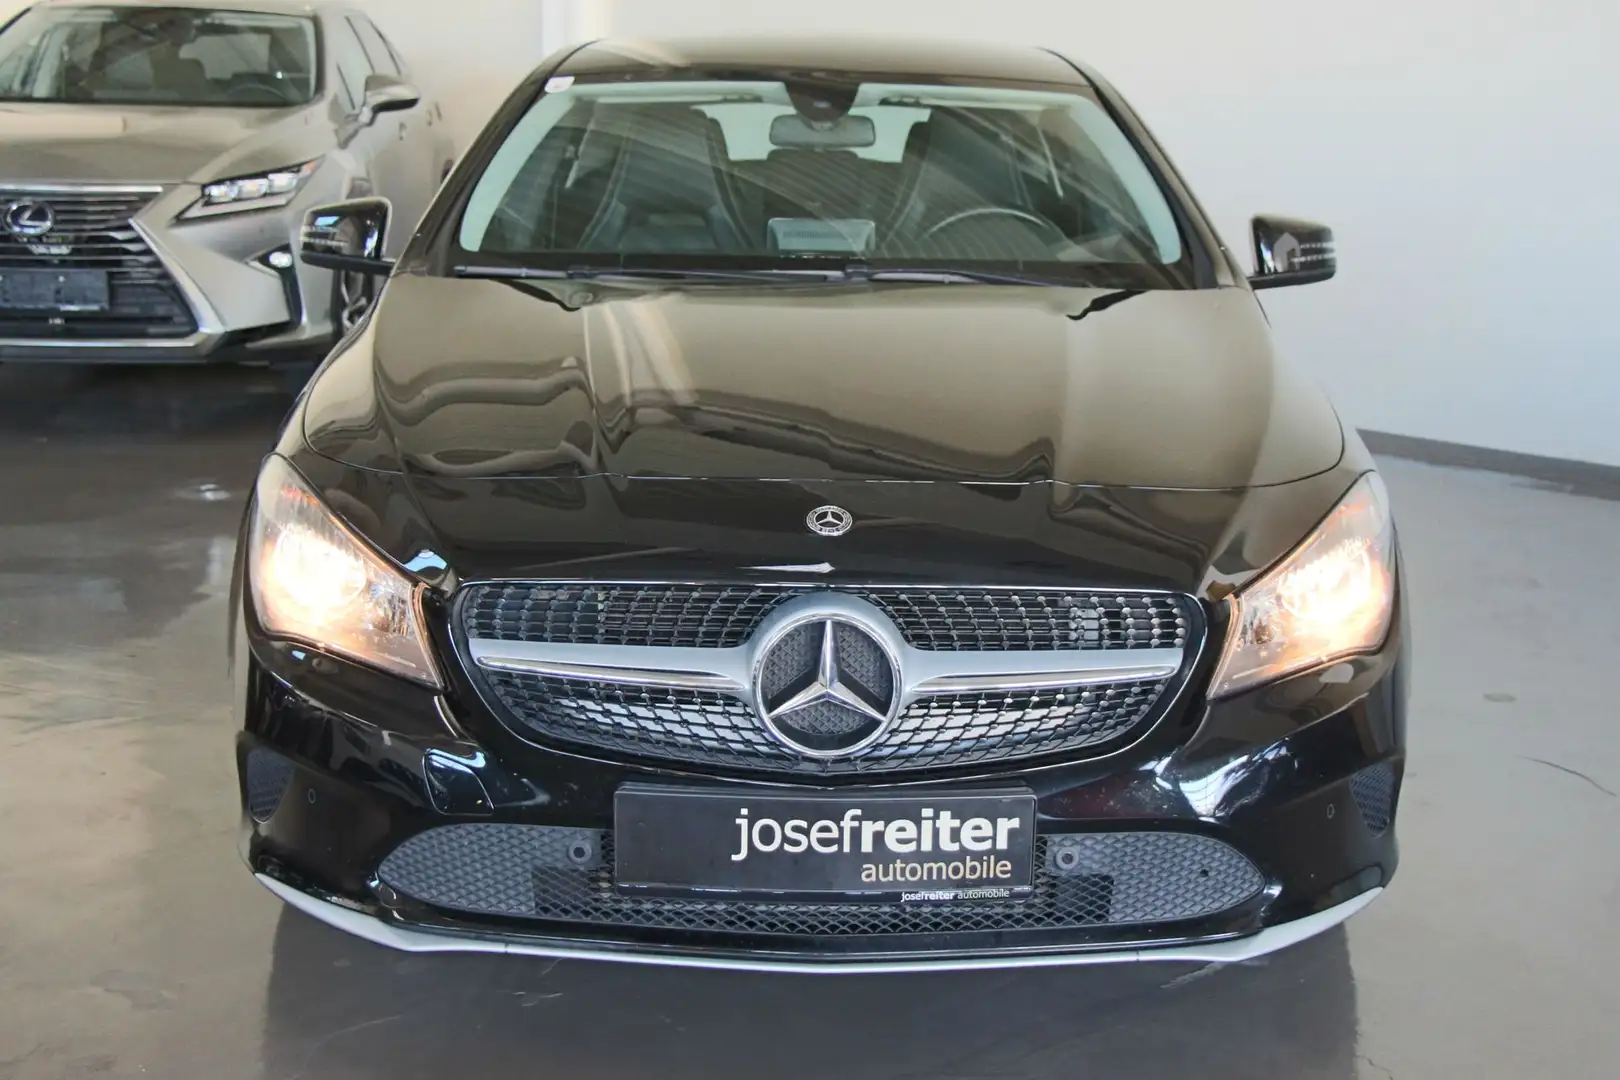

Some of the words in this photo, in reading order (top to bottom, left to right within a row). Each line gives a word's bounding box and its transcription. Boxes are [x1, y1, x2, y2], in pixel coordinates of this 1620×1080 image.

[731, 807, 1020, 860] josefreiter
[861, 856, 1012, 882] automobile
[901, 891, 955, 902] josefreiter
[957, 889, 1010, 899] automobile
